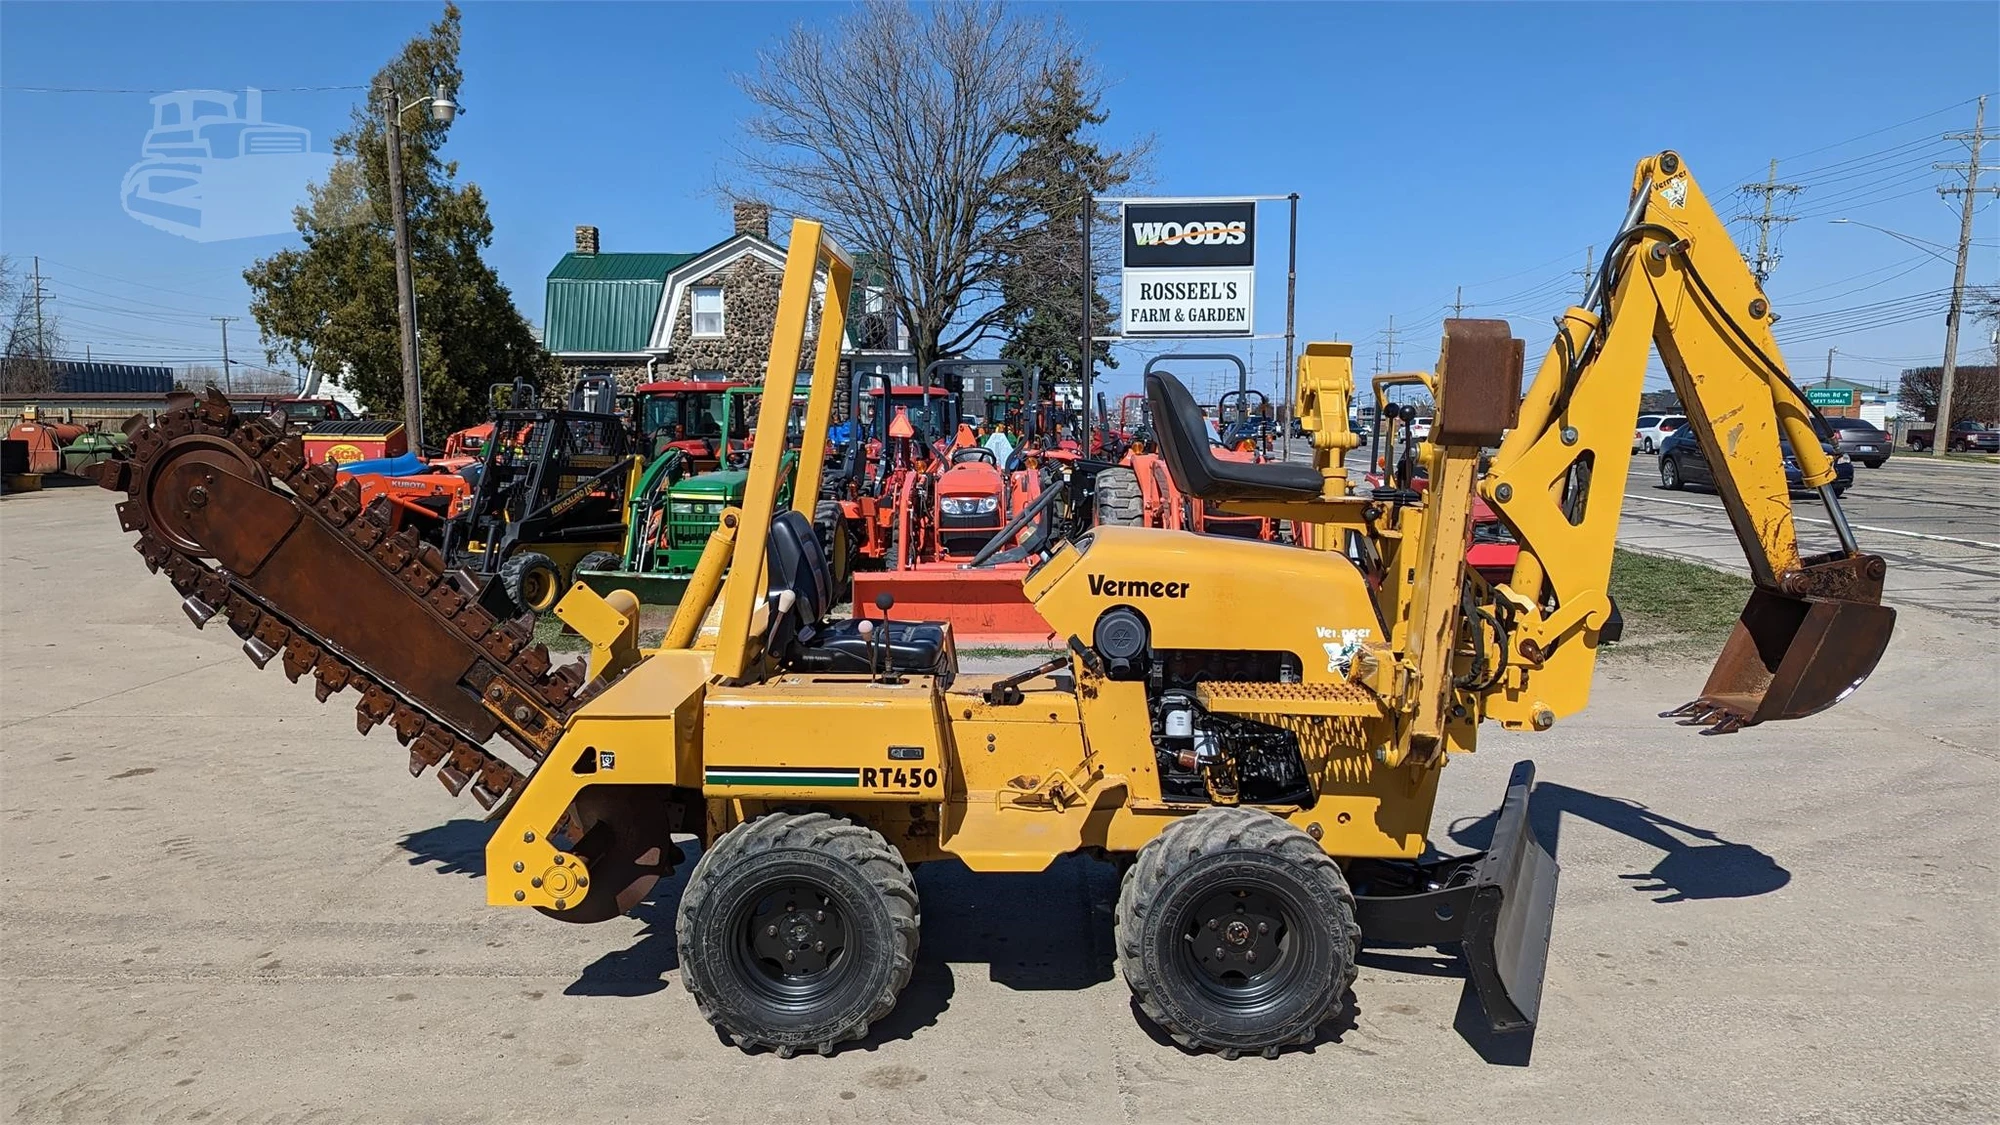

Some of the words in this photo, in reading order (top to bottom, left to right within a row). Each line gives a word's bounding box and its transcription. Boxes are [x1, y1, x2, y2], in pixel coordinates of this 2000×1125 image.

[1132, 221, 1246, 246] WOODS
[1140, 281, 1237, 301] ROSSEEL'S
[1131, 308, 1170, 322] FARM
[1174, 308, 1185, 322] &
[1188, 307, 1246, 322] GARDEN
[391, 480, 426, 489] KUBOTA
[562, 489, 585, 508] HOLLAND
[1087, 574, 1190, 599] Vermeer
[862, 767, 938, 789] RT450
